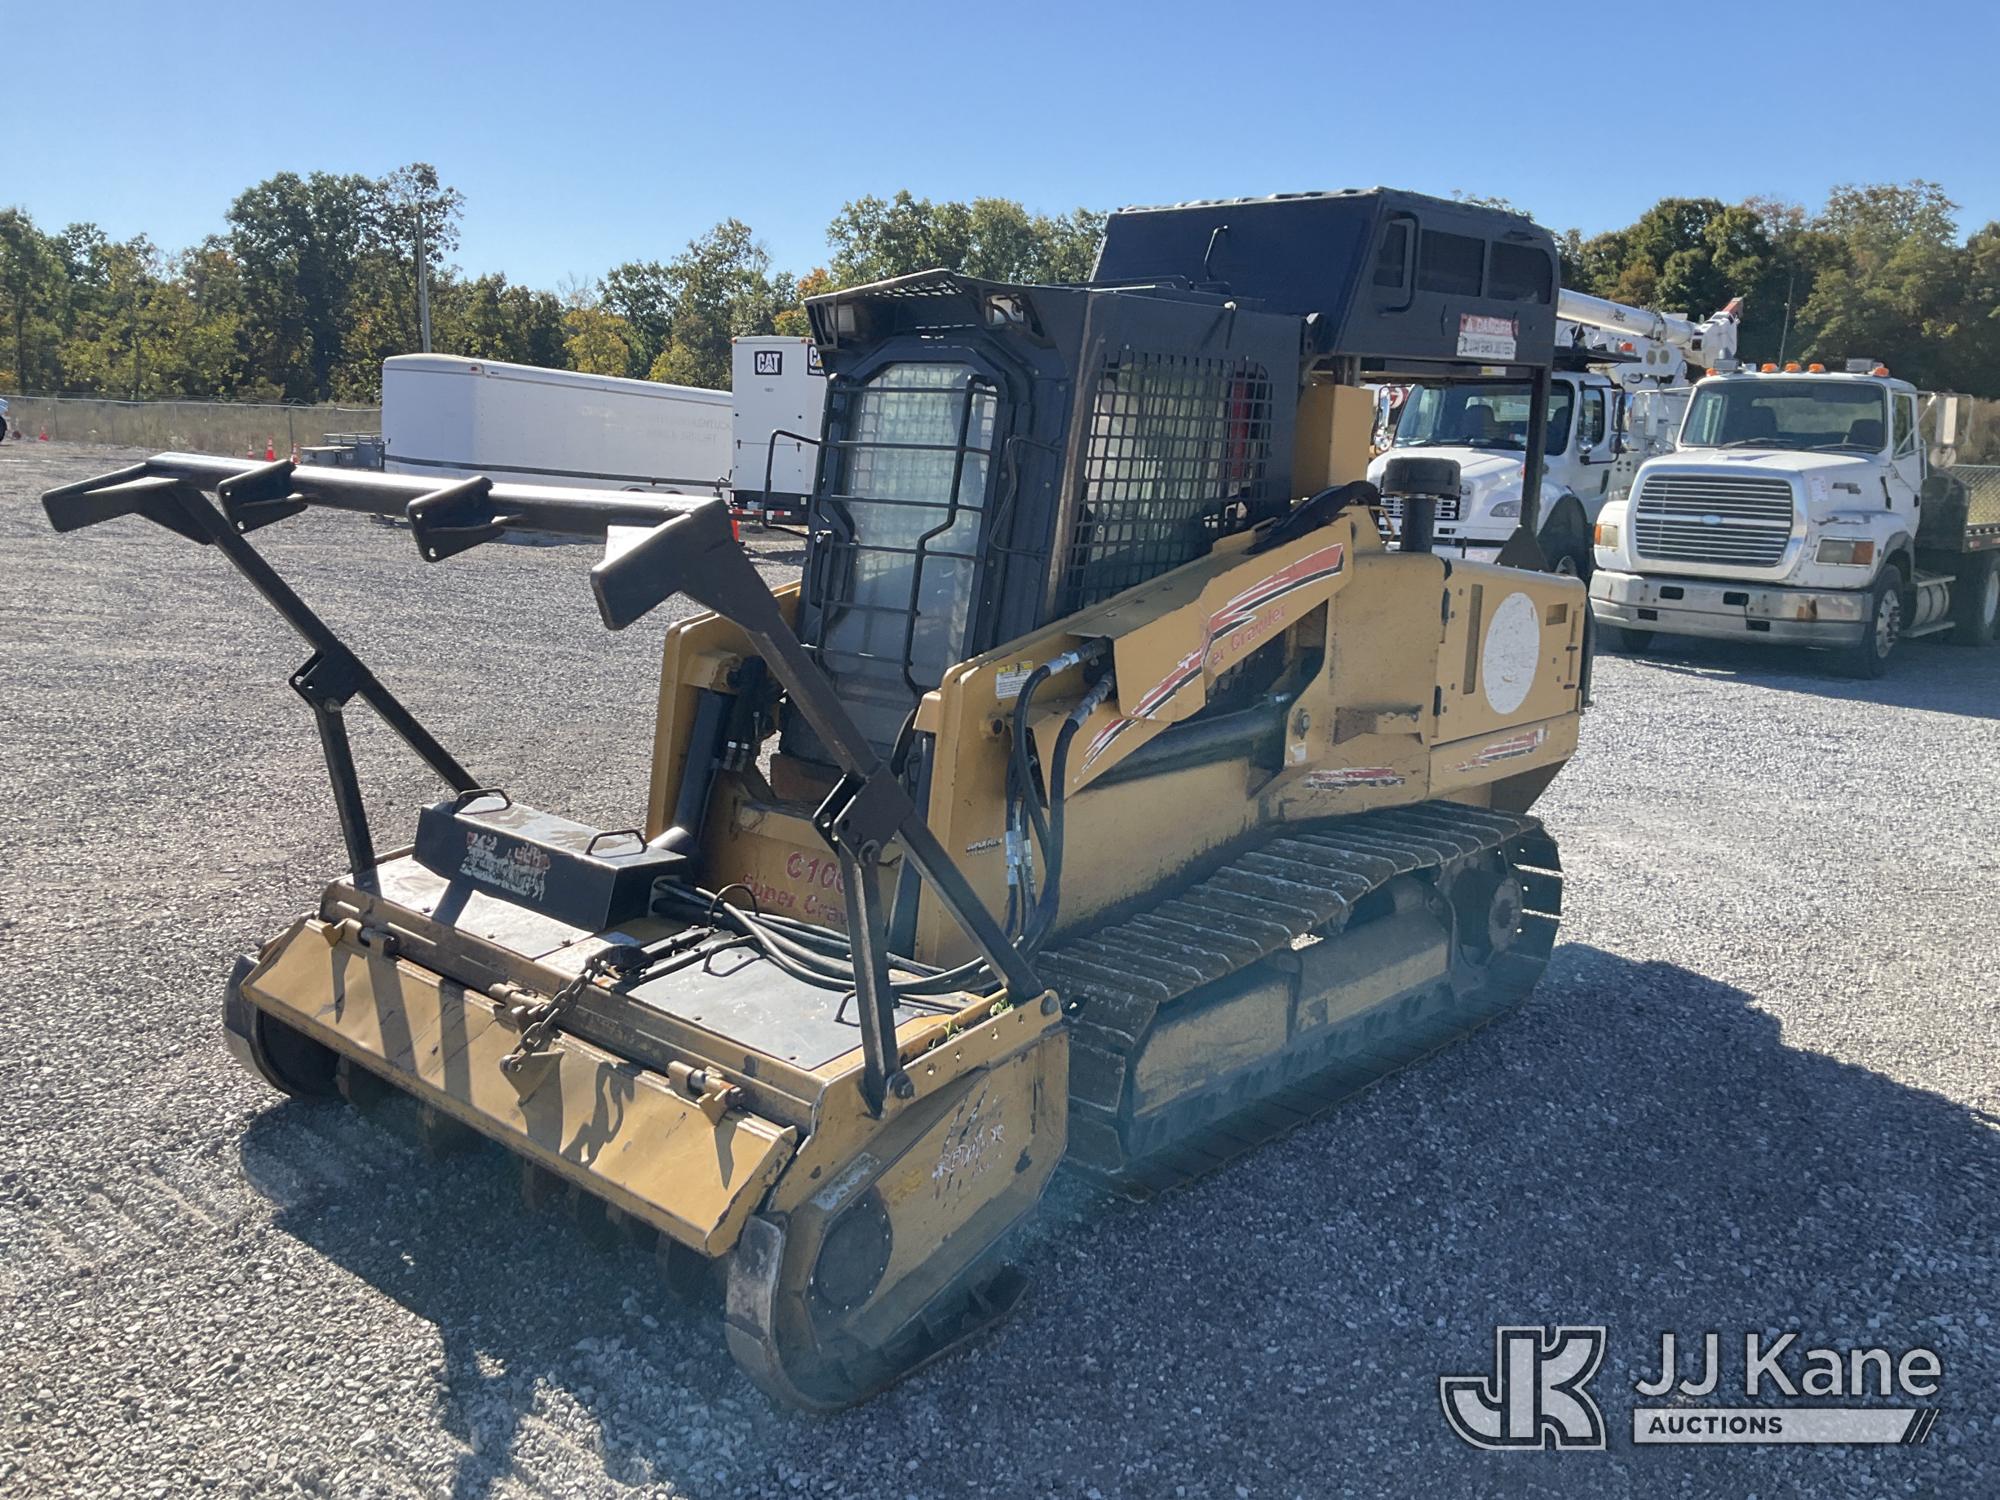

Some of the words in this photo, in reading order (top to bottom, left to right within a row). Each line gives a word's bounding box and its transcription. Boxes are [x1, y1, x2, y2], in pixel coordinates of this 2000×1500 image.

[757, 353, 780, 373] CAT
[809, 346, 823, 367] CA
[1232, 605, 1285, 651] Crawler
[743, 873, 796, 908] Super
